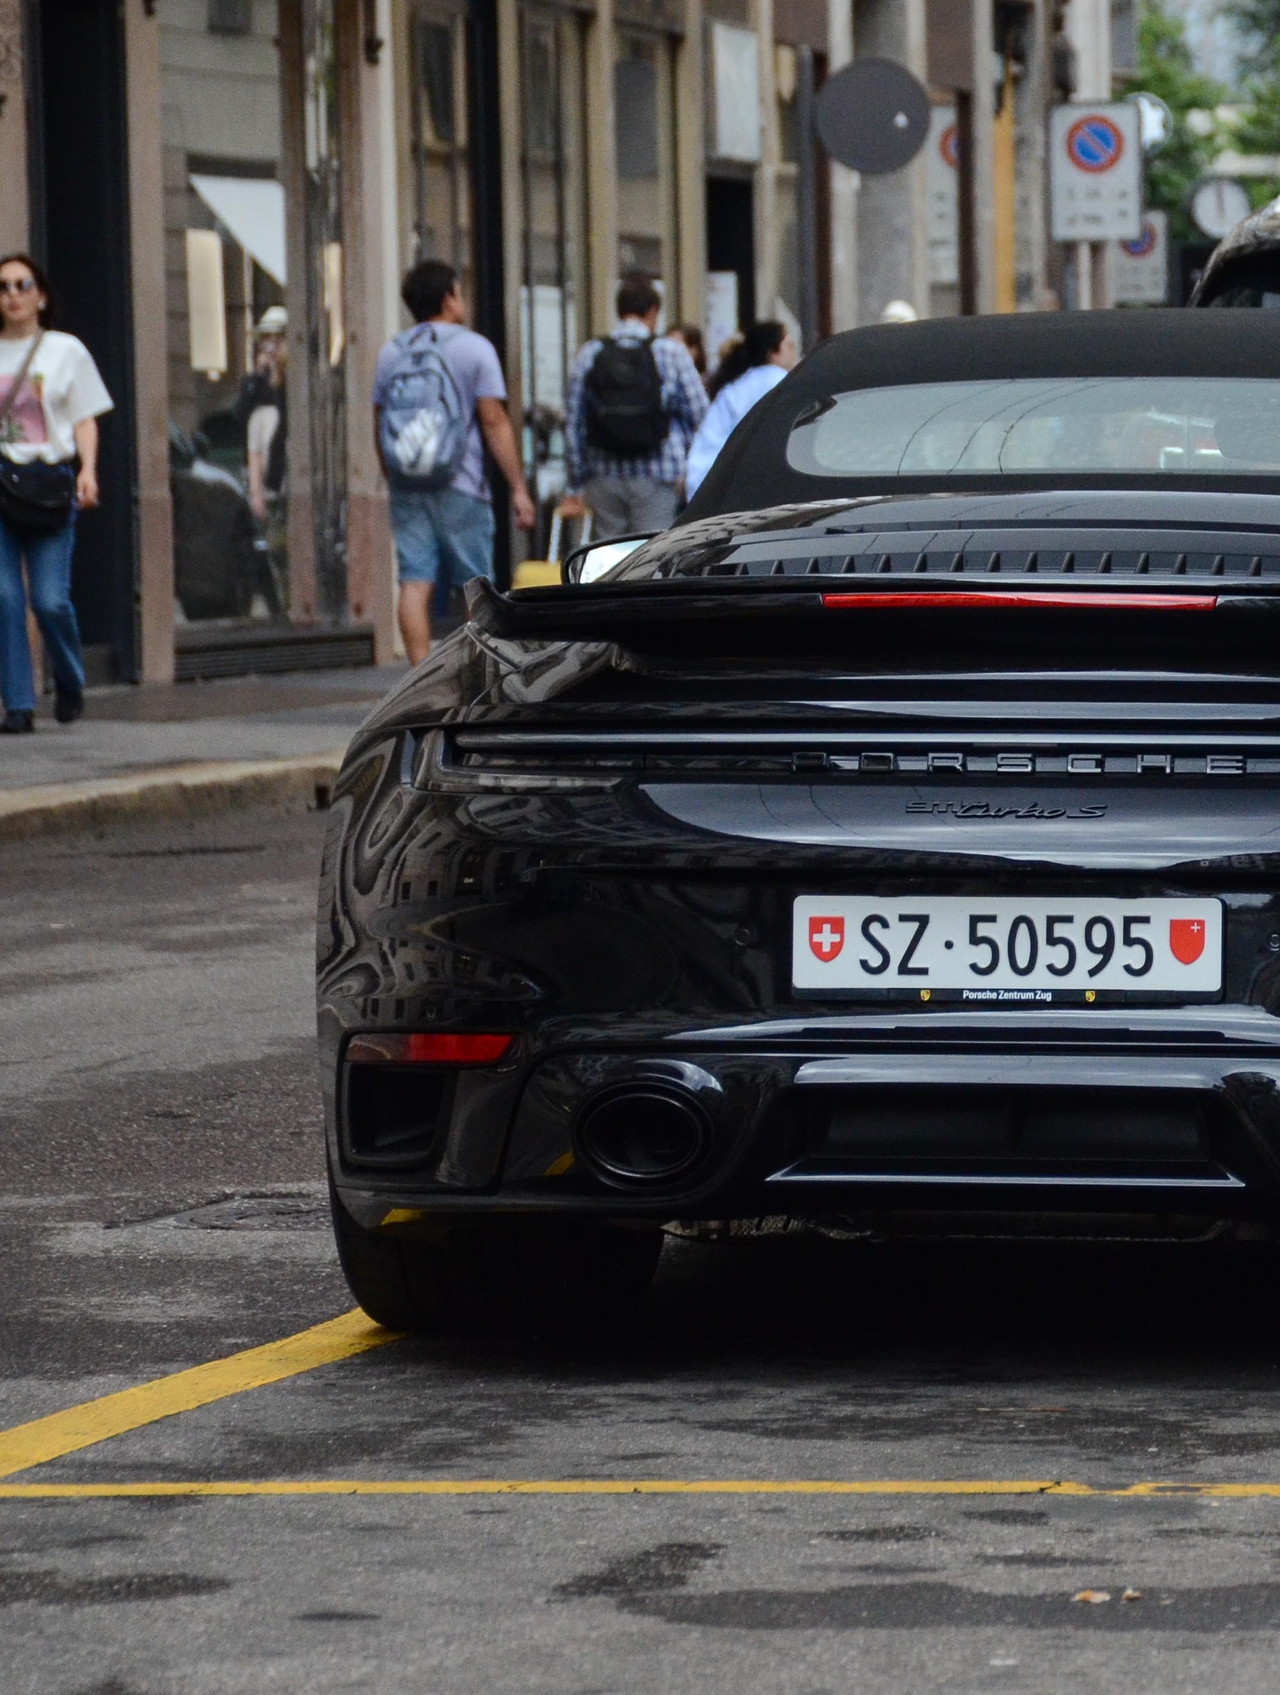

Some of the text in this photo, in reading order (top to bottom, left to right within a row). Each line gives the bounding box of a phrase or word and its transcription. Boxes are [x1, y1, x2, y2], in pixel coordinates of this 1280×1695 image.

[791, 752, 1246, 774] PORSCHE
[1067, 804, 1108, 818] S
[963, 990, 1052, 1002] Porsche Zentrum Zug
